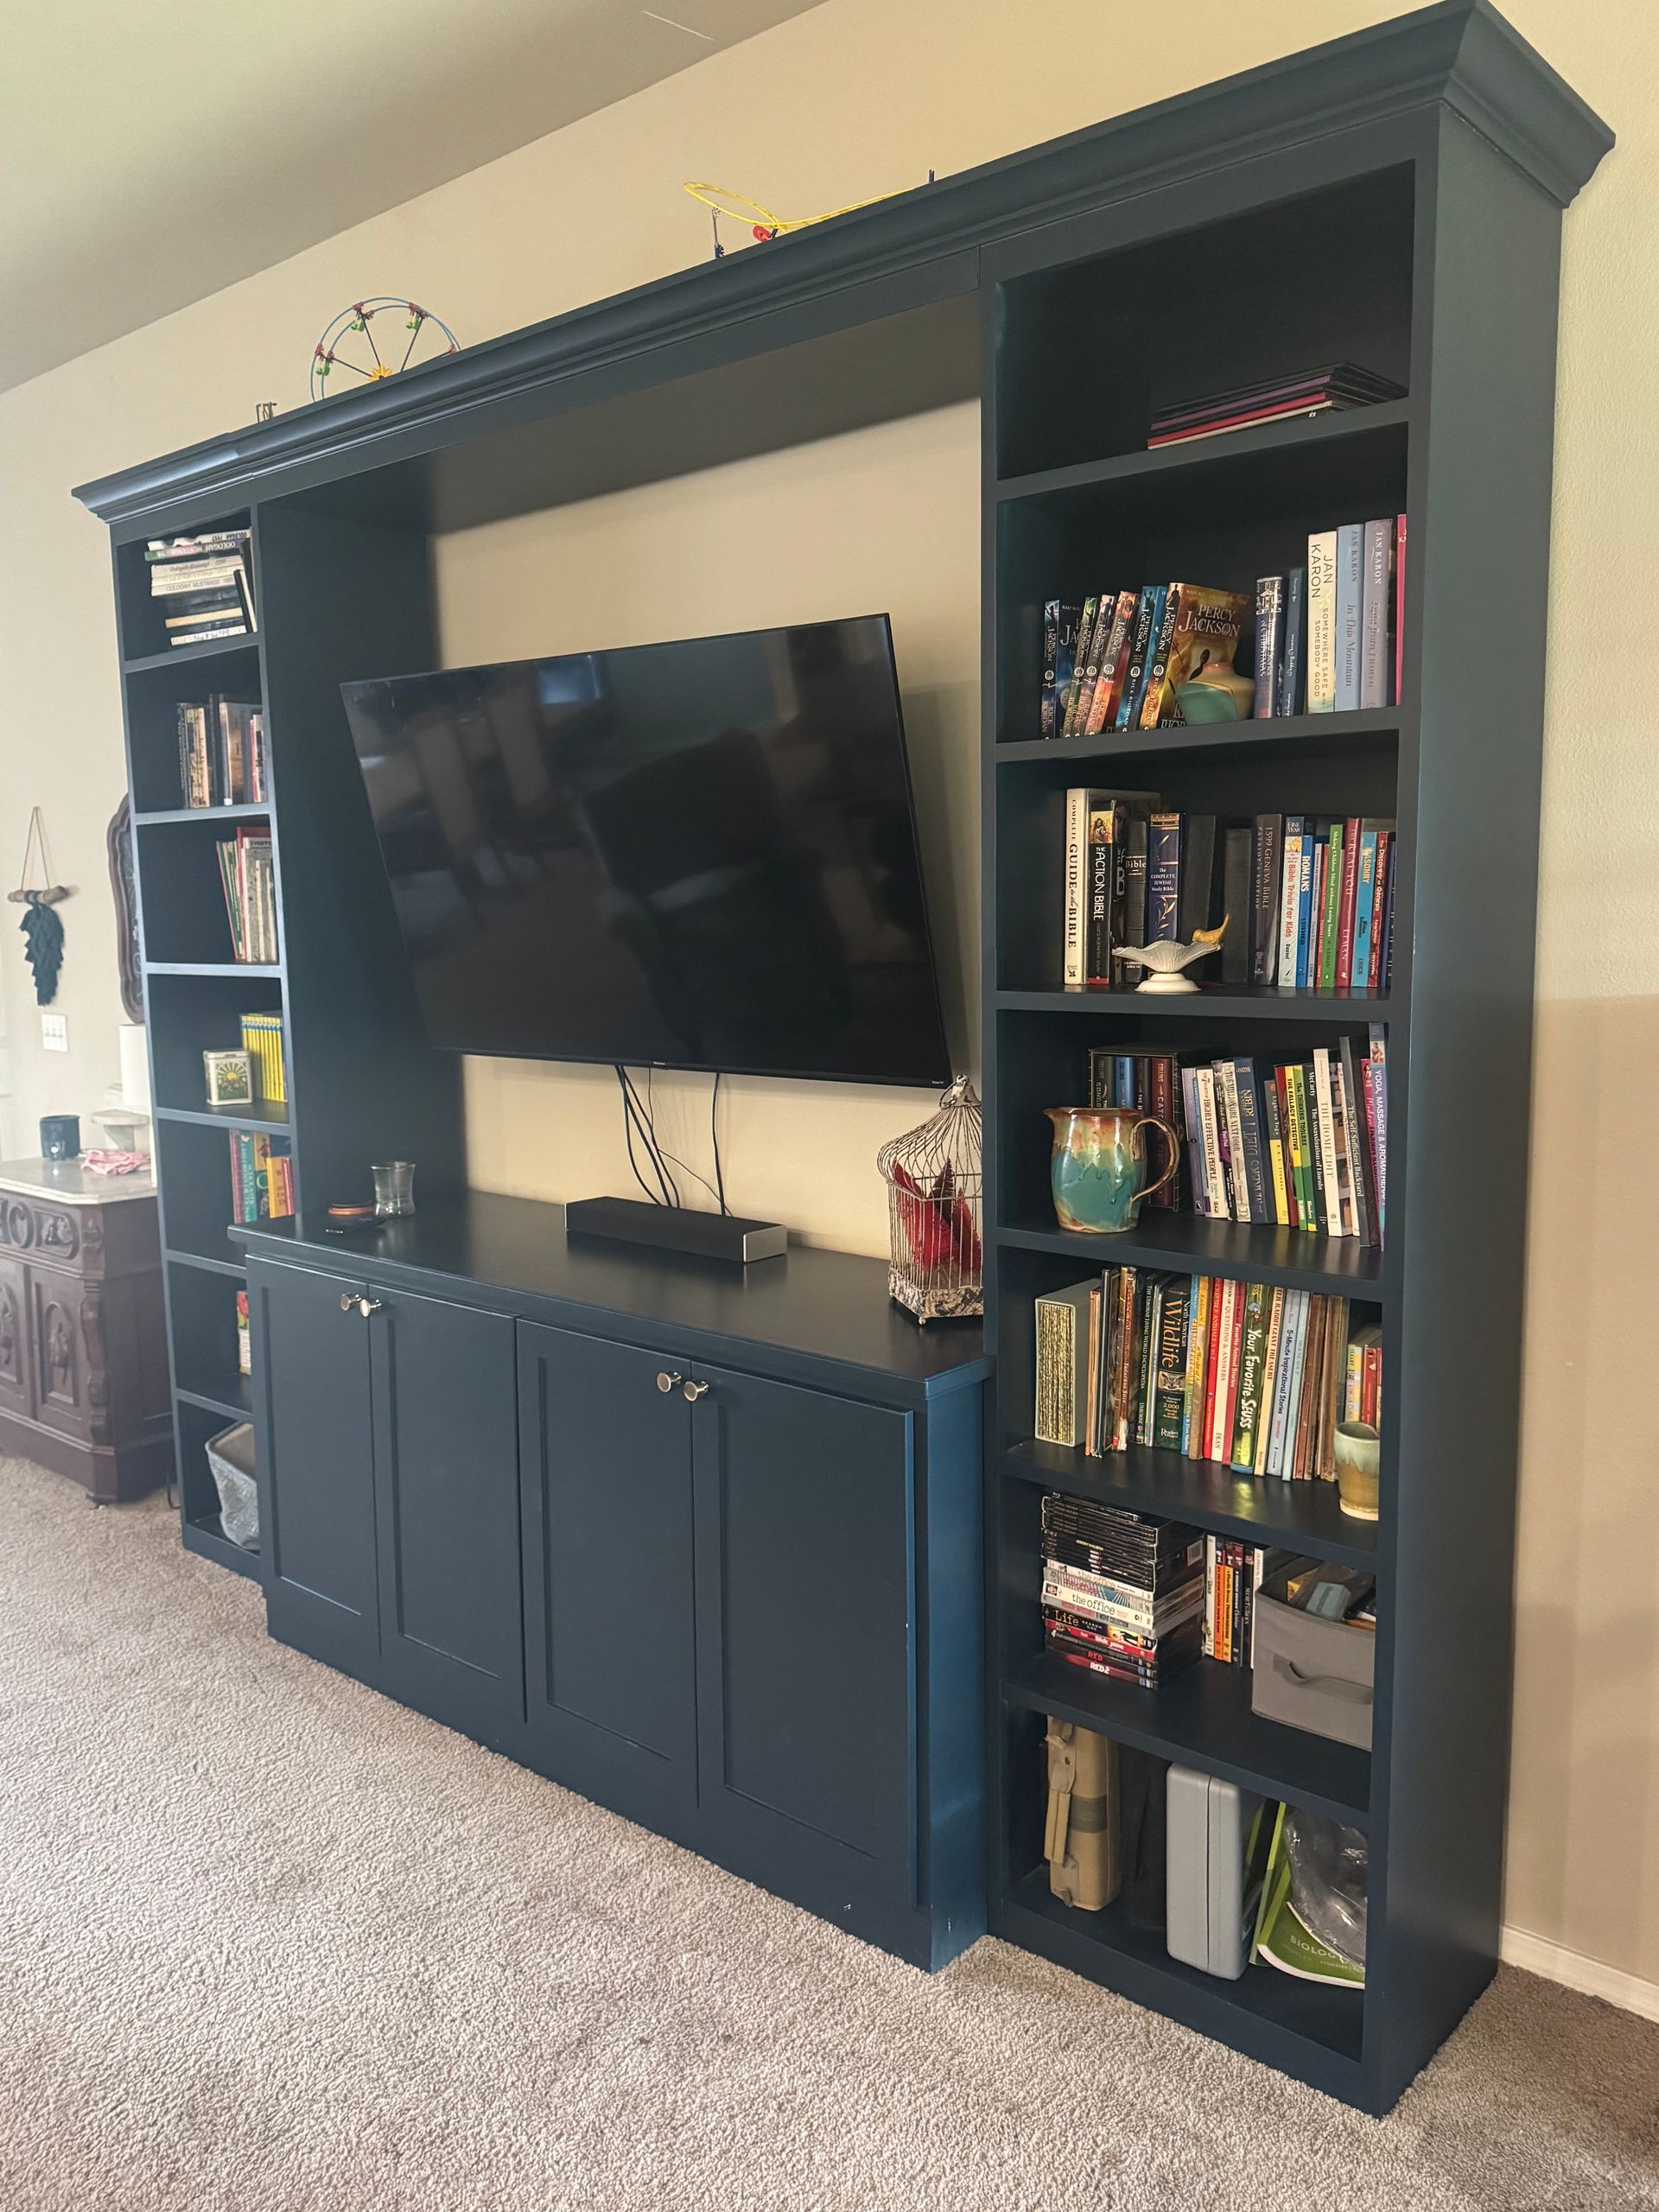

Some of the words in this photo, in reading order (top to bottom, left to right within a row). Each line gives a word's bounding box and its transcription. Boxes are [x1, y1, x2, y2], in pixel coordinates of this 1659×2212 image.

[1311, 543, 1321, 598] KARON
[1323, 555, 1334, 583] JAN
[1374, 552, 1382, 585] KARON
[1178, 609, 1242, 638] JACKSON
[1198, 604, 1236, 622] PERCY
[1346, 604, 1356, 616] In
[1135, 607, 1150, 652] JACKSON
[1142, 615, 1151, 646] PERCY
[1158, 602, 1175, 651] JACKSON
[1166, 613, 1175, 644] PERCY
[1345, 619, 1356, 638] This
[1046, 626, 1055, 663] JACKSON
[1344, 640, 1356, 687] Mountain
[1124, 696, 1134, 727] RIORDAN
[1069, 843, 1077, 889] GUIDE
[1126, 859, 1147, 868] Bible
[1262, 849, 1272, 885] GENEVA
[1347, 842, 1357, 871] REAL
[1376, 849, 1386, 880] Discovery
[1094, 852, 1105, 893] ACTION
[1287, 863, 1296, 882] Bible
[1300, 855, 1311, 893] ROMANS
[1345, 872, 1354, 895] YOU
[1093, 895, 1104, 922] BIBLE
[1262, 887, 1271, 910] BIBLE
[1286, 884, 1295, 906] Trivia
[1374, 885, 1383, 912] Genesis
[1285, 907, 1294, 920] for
[1068, 907, 1077, 949] BIBLE
[1284, 920, 1294, 938] Kids
[1341, 929, 1351, 960] LEMAN
[1224, 1071, 1233, 1081] THE
[1374, 1069, 1382, 1093] YOGA,
[1203, 1098, 1212, 1122] HIGHLY
[1225, 1081, 1237, 1119] MILLIONAIRE
[1244, 1090, 1254, 1117] RUBIN
[1320, 1101, 1329, 1122] THE
[1229, 1119, 1239, 1135] NEXT
[1376, 1096, 1385, 1135] MASSAGE
[1204, 1121, 1215, 1156] EFFECTIVE
[1231, 1135, 1241, 1152] DOOR
[1243, 1130, 1256, 1156] DIET
[1290, 1117, 1299, 1151] DETECTIVE
[1312, 1119, 1321, 1160] Assassination
[1321, 1122, 1332, 1152] HOME
[1208, 1156, 1217, 1180] PEOPLE
[1324, 1154, 1334, 1178] EDIT
[1349, 1119, 1358, 1165] Self-Sufficient
[1354, 1164, 1364, 1197] Backyard
[1182, 1300, 1191, 1319] North
[1273, 1302, 1281, 1326] RABBIT
[1161, 1300, 1183, 1369] Wildlife
[1180, 1318, 1189, 1347] American
[1223, 1305, 1232, 1343] QUESTIONS
[1270, 1325, 1279, 1347] GIANT
[1247, 1328, 1262, 1352] Your
[1285, 1329, 1294, 1356] 5-Minute
[1219, 1350, 1228, 1382] ANSWERS
[1244, 1355, 1260, 1397] Favorite
[1266, 1347, 1276, 1381] TREASURY
[1281, 1355, 1292, 1395] Inspirational
[1239, 1398, 1257, 1430] SEUSS
[1277, 1394, 1287, 1414] Stories
[1077, 1570, 1092, 1582] the
[1054, 1610, 1079, 1627] Life
[1071, 1593, 1086, 1606] the
[1086, 1599, 1116, 1617] office
[1087, 1650, 1103, 1662] RED
[1090, 1662, 1104, 1672] RED
[1103, 1666, 1110, 1675] 2
